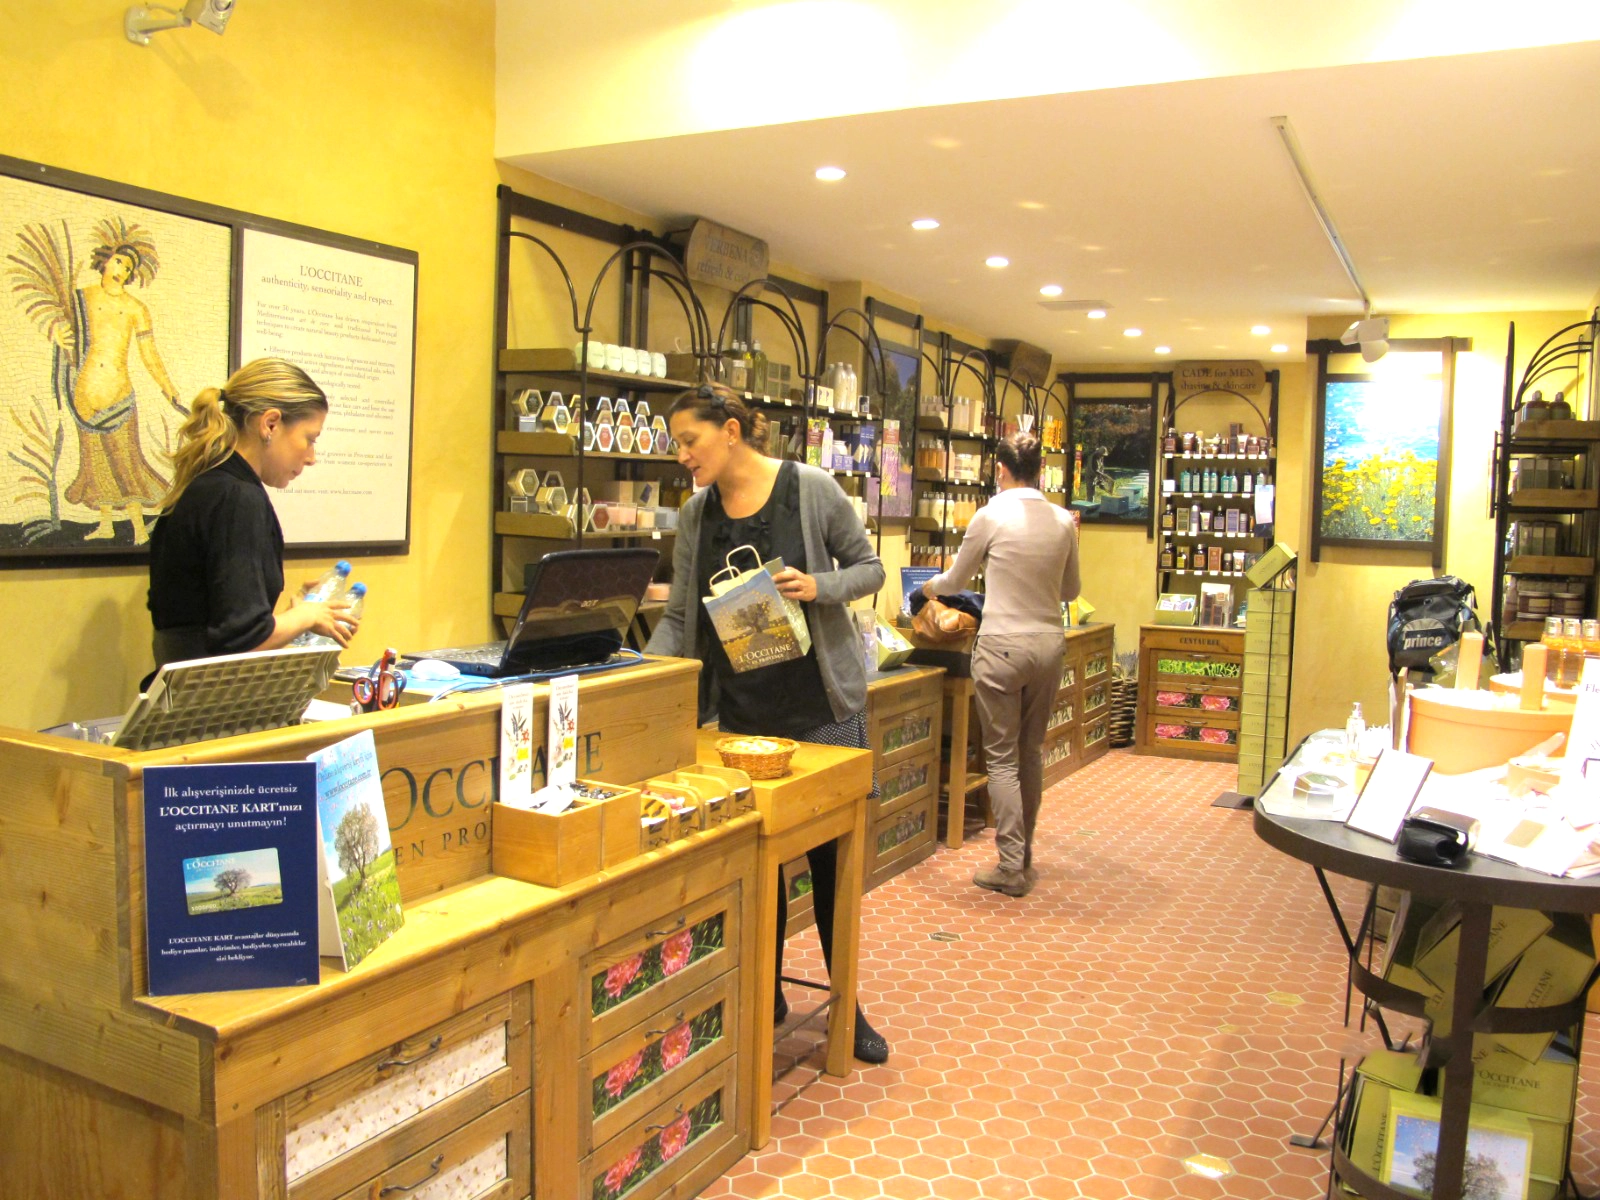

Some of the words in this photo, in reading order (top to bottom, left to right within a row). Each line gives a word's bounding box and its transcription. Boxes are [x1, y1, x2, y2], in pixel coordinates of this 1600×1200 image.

[300, 265, 363, 287] L'OCCITANE
[261, 275, 309, 292] authenticity,
[311, 284, 352, 300] sensoriality
[354, 292, 366, 302] and
[368, 295, 394, 306] respect.
[1229, 368, 1254, 377] MEN
[1403, 634, 1443, 650] prince
[739, 643, 791, 663] L'OCCITANE
[182, 784, 256, 799] alışverişinizde
[258, 783, 298, 794] ücretsiz
[160, 804, 239, 817] L'OCCITANE
[242, 802, 302, 814] KART'ınızı
[175, 821, 224, 833] açtırmayı
[227, 816, 287, 830] unutmayın!
[169, 935, 212, 945] L'OCCITANE
[214, 934, 234, 942] KART
